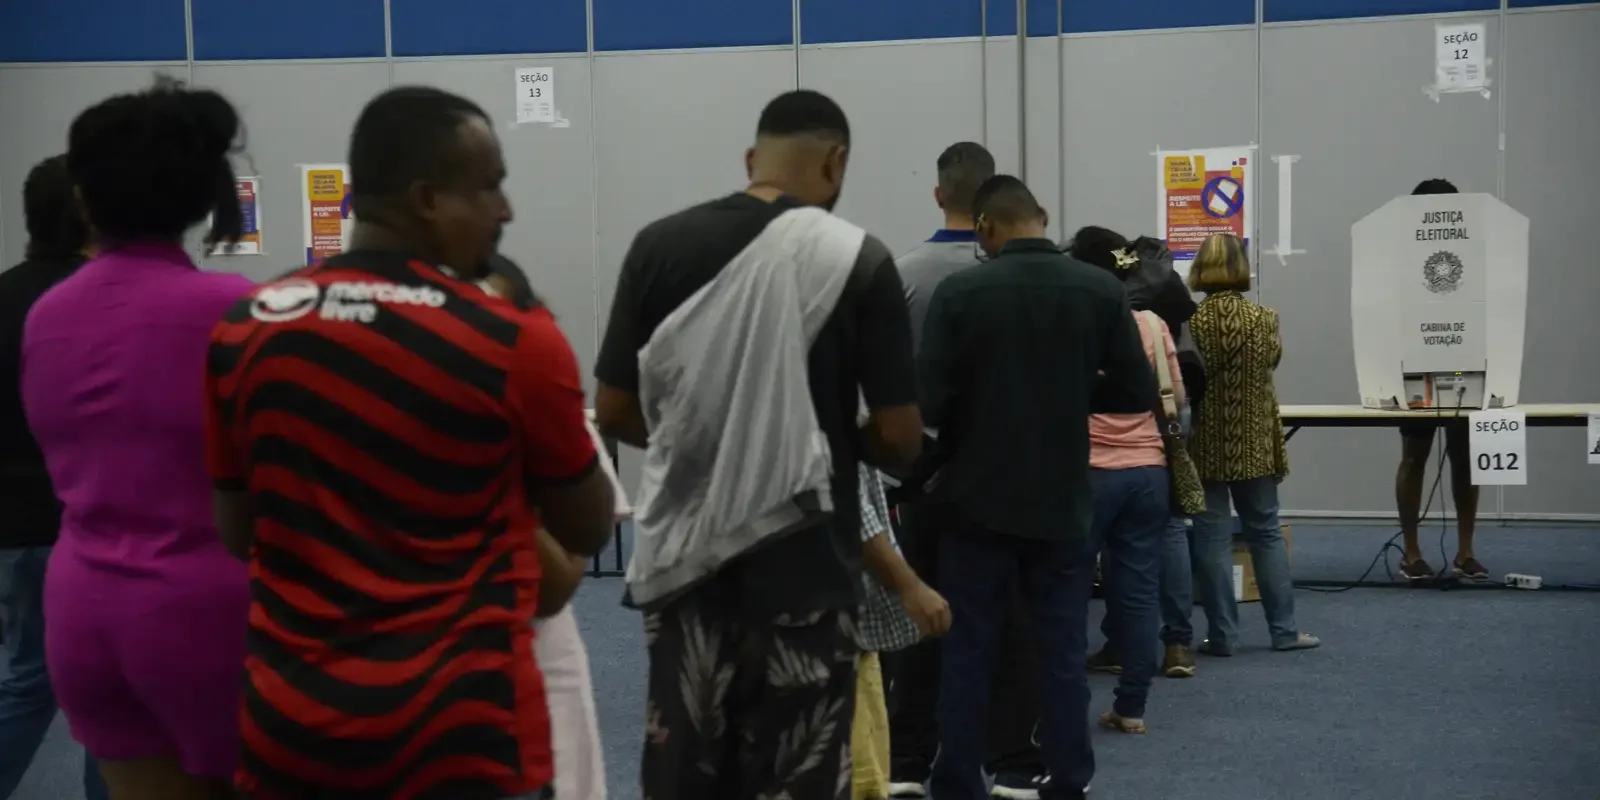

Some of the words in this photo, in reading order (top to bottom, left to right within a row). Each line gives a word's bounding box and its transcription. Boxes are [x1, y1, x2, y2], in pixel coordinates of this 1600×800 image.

[1444, 31, 1478, 45] SEÇÃO
[1454, 49, 1469, 60] 12
[520, 72, 549, 84] SEÇÃO
[529, 88, 542, 98] 13
[1422, 210, 1464, 226] JUSTIÇA
[1416, 228, 1469, 241] ELEITORAL
[1420, 322, 1452, 332] CABINA
[1453, 322, 1466, 332] DE
[1423, 333, 1463, 347] VOTAÇÃO
[1475, 419, 1519, 434] SEÇÃO
[1477, 453, 1519, 471] 012
